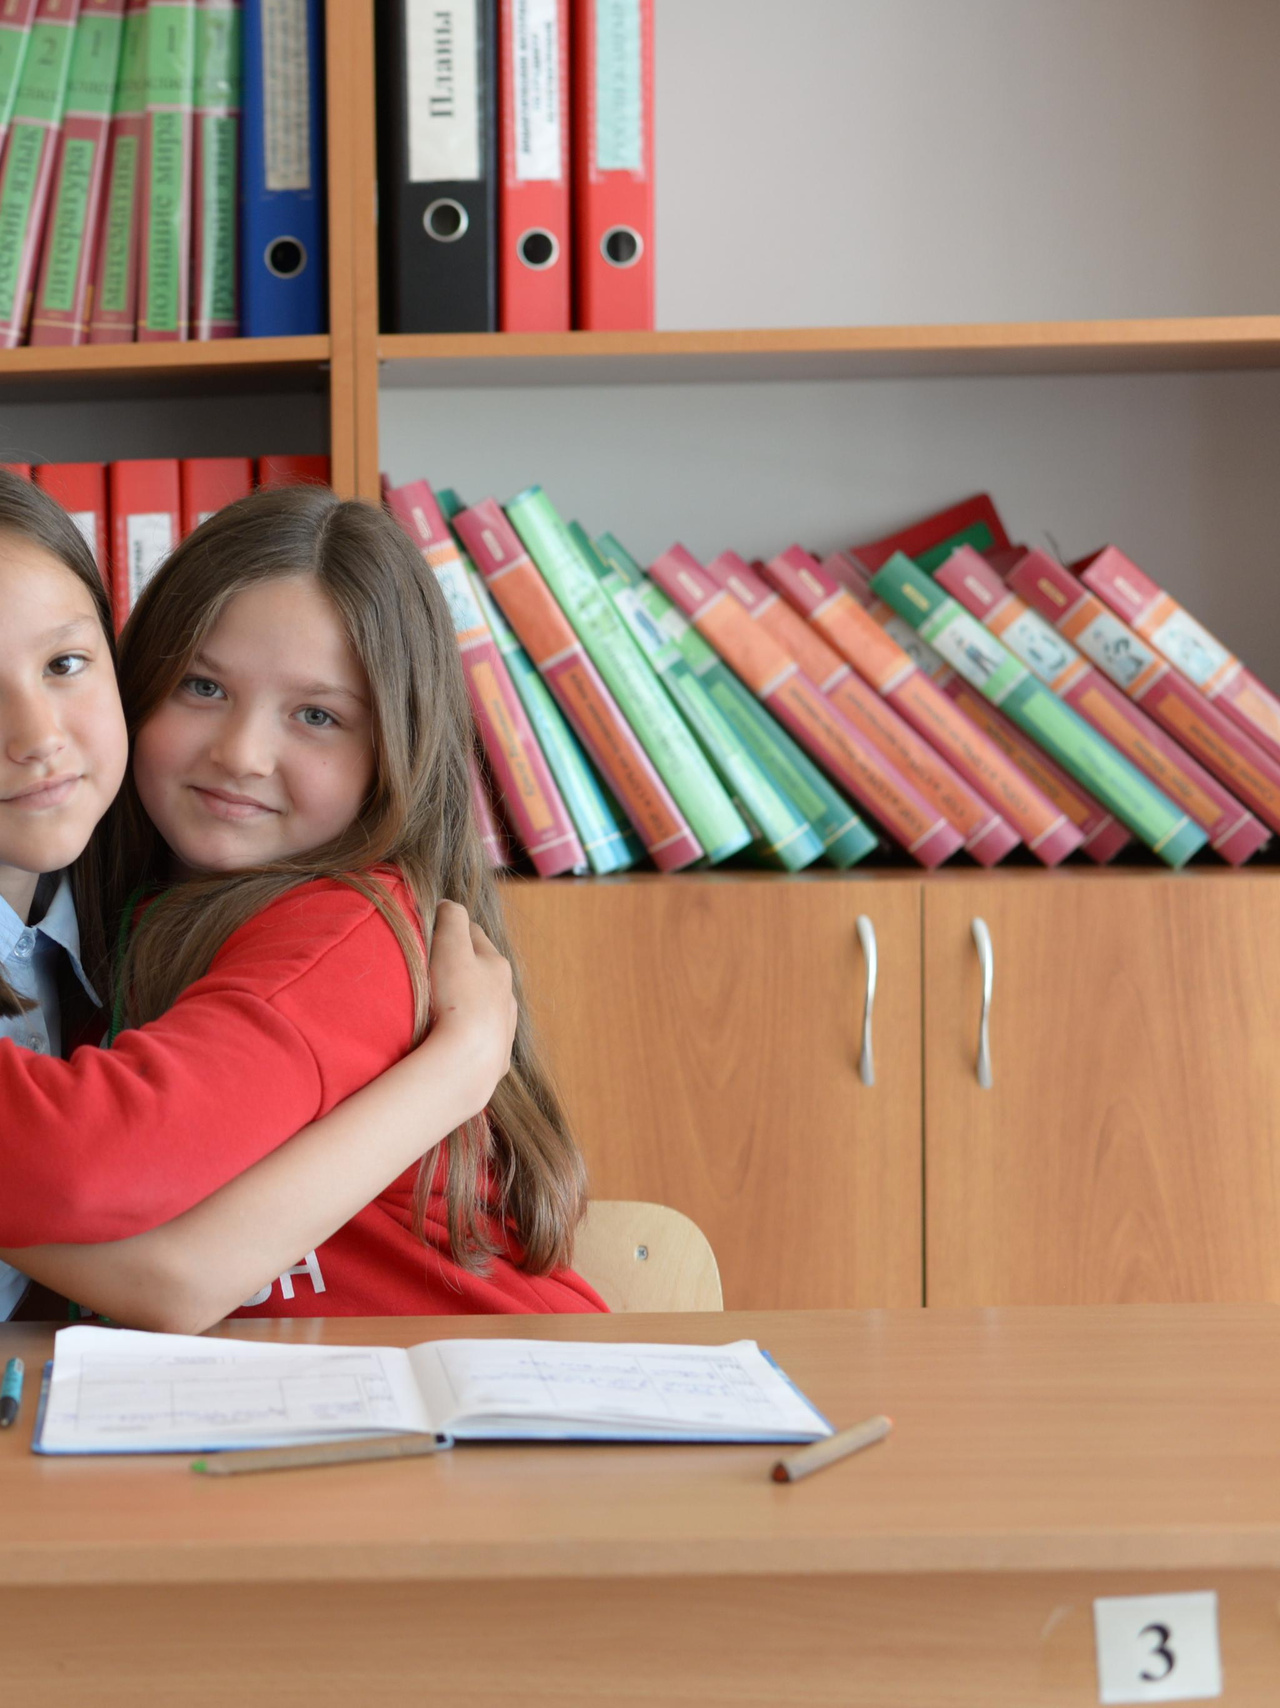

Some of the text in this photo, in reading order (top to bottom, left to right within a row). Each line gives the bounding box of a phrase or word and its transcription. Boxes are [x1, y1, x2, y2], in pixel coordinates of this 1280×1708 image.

[428, 11, 454, 117] Планы
[150, 113, 182, 327] познание мира
[1137, 1623, 1176, 1682] 3
